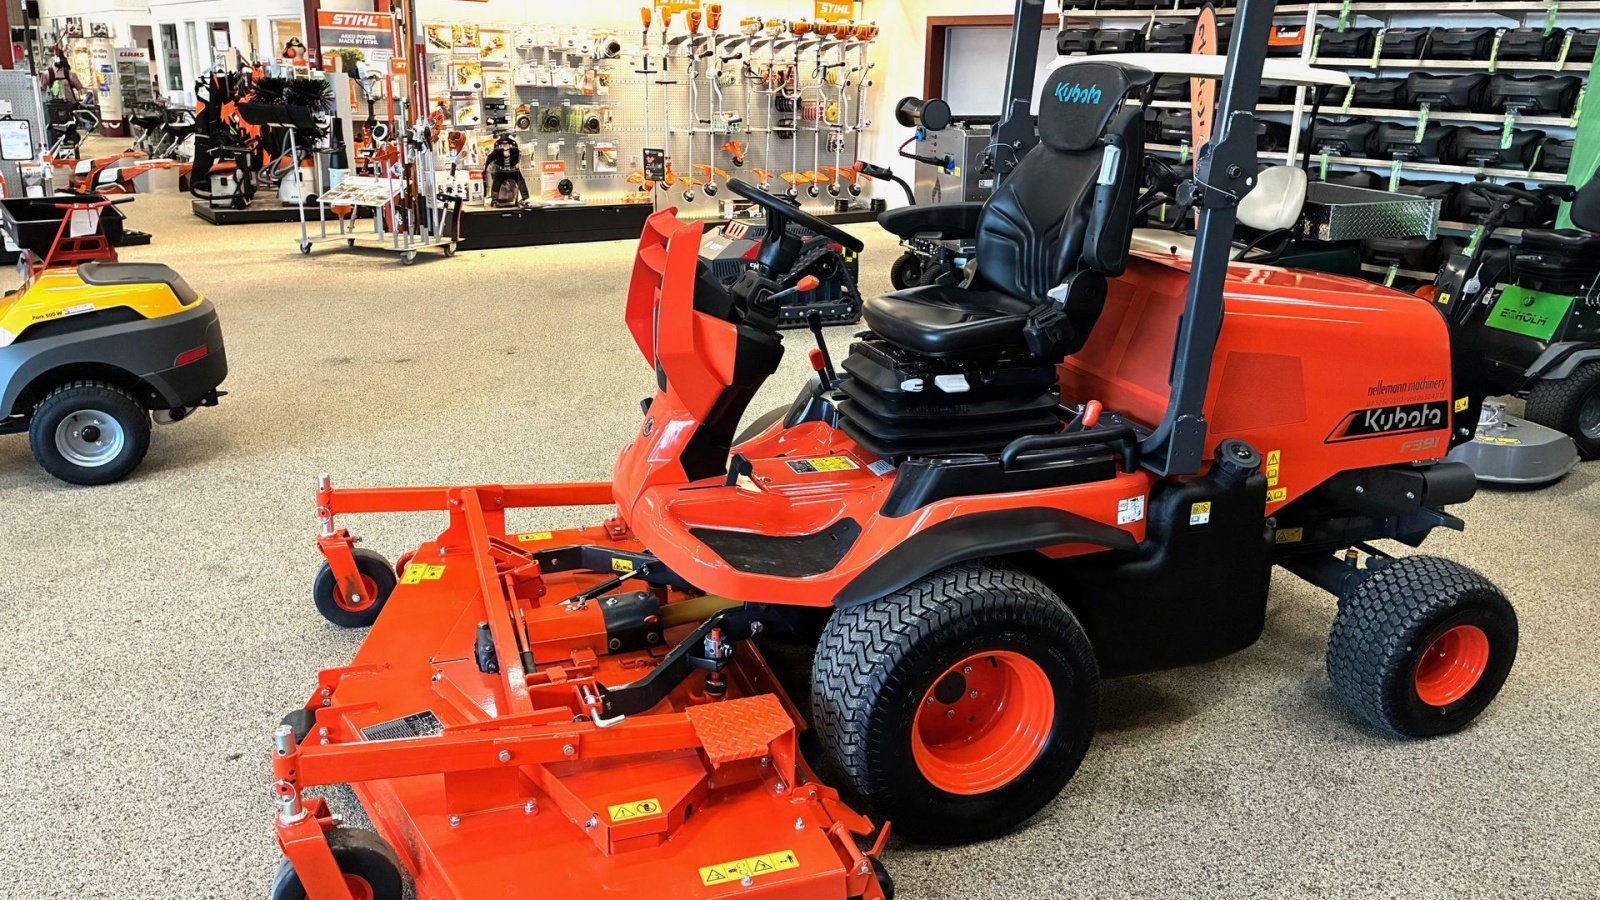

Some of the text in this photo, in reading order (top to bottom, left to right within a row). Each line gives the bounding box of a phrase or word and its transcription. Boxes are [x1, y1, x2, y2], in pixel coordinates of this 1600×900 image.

[820, 3, 851, 15] STIHL
[332, 14, 378, 26] STIHL
[1054, 82, 1102, 105] Kubota
[1367, 376, 1447, 397] nellemann machinery
[1365, 403, 1442, 432] Kubota
